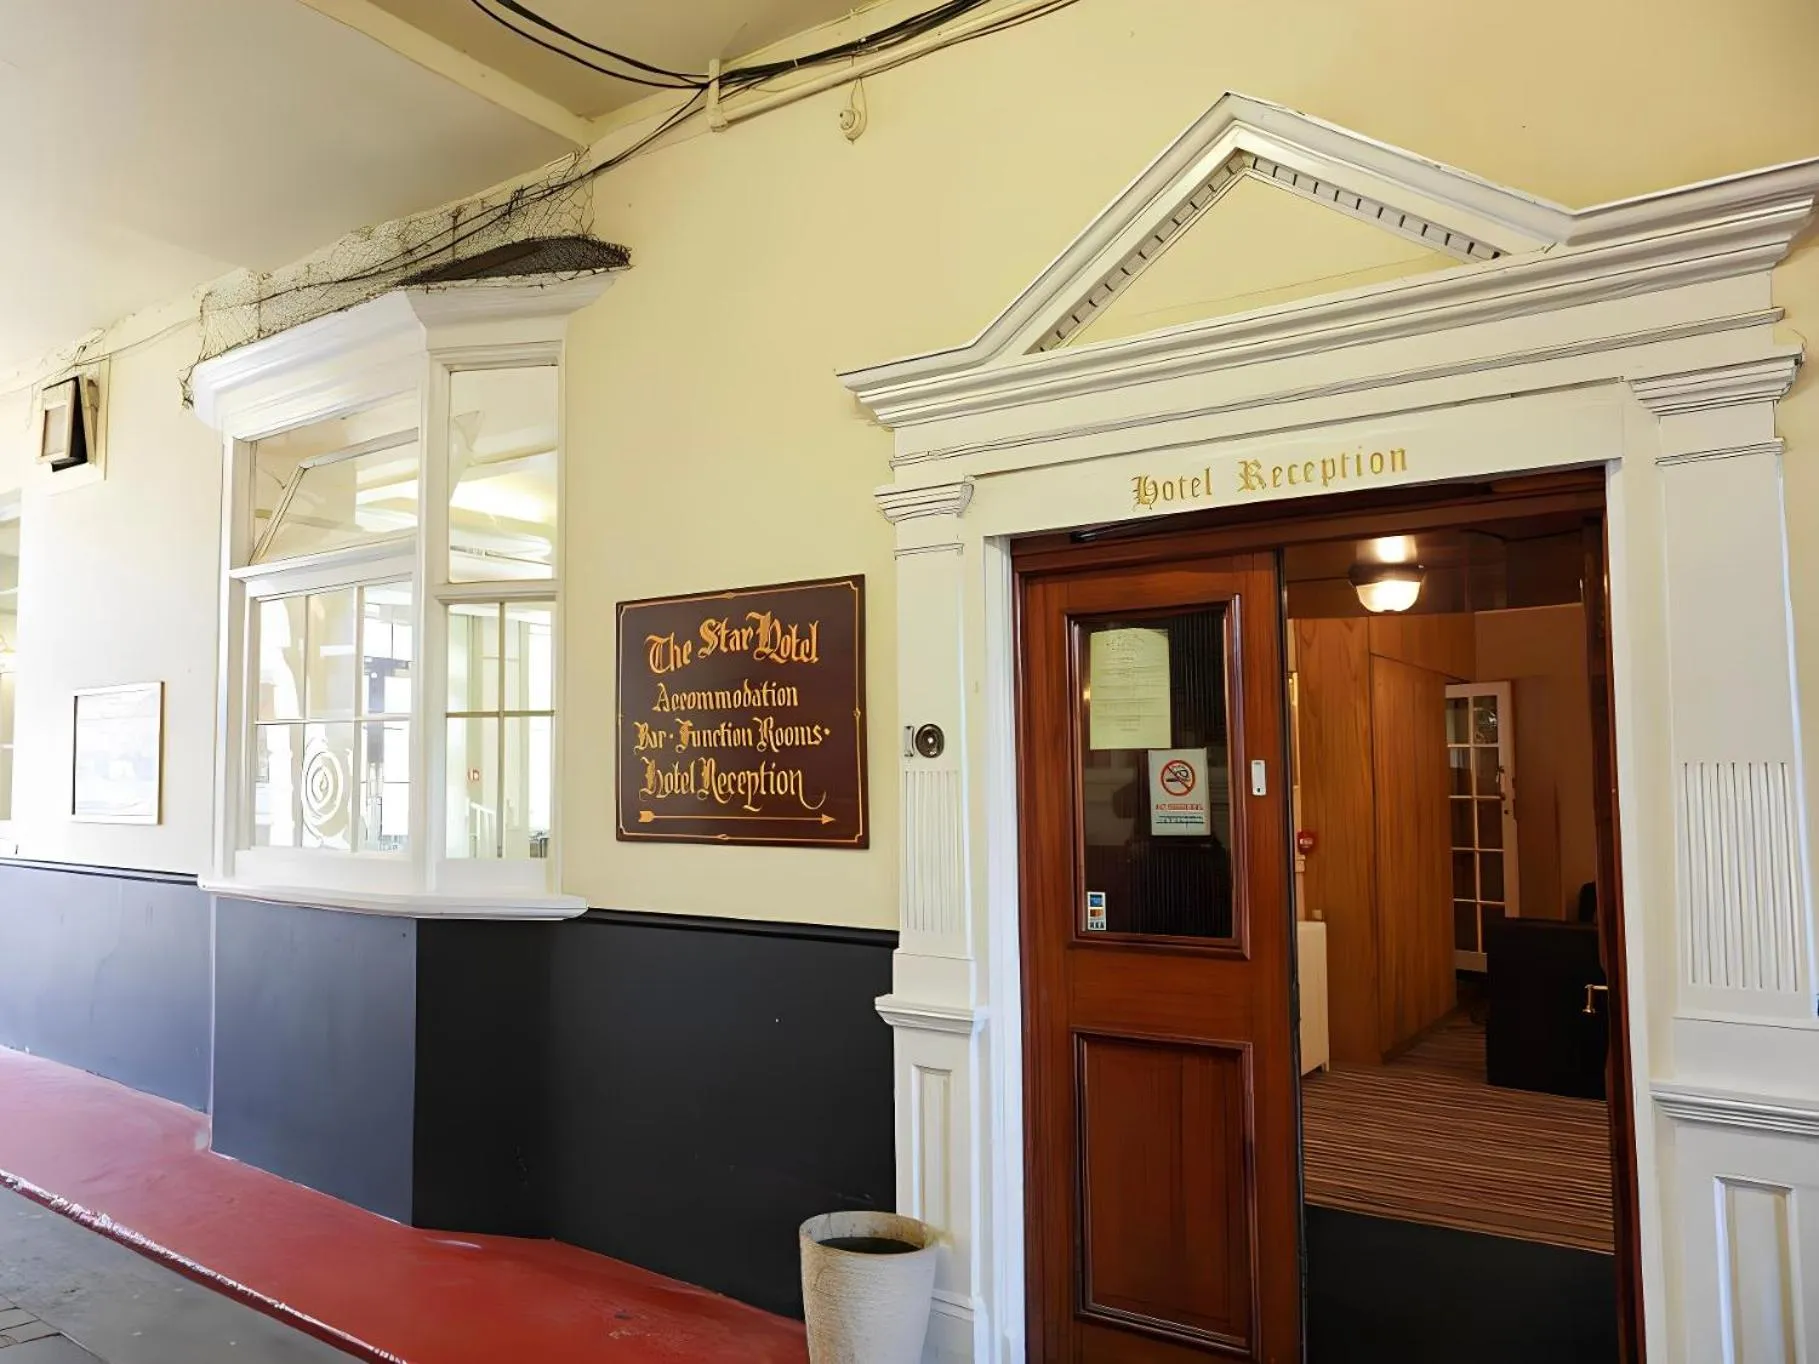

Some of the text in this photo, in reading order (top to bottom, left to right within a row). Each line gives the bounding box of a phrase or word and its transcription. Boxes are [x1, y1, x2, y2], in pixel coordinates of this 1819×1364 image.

[1131, 446, 1407, 511] Hotel Reception
[644, 611, 819, 674] The Star Hotel
[652, 679, 799, 713] Accommodation
[675, 718, 752, 753] Function
[639, 756, 827, 811] Hotel Reception
